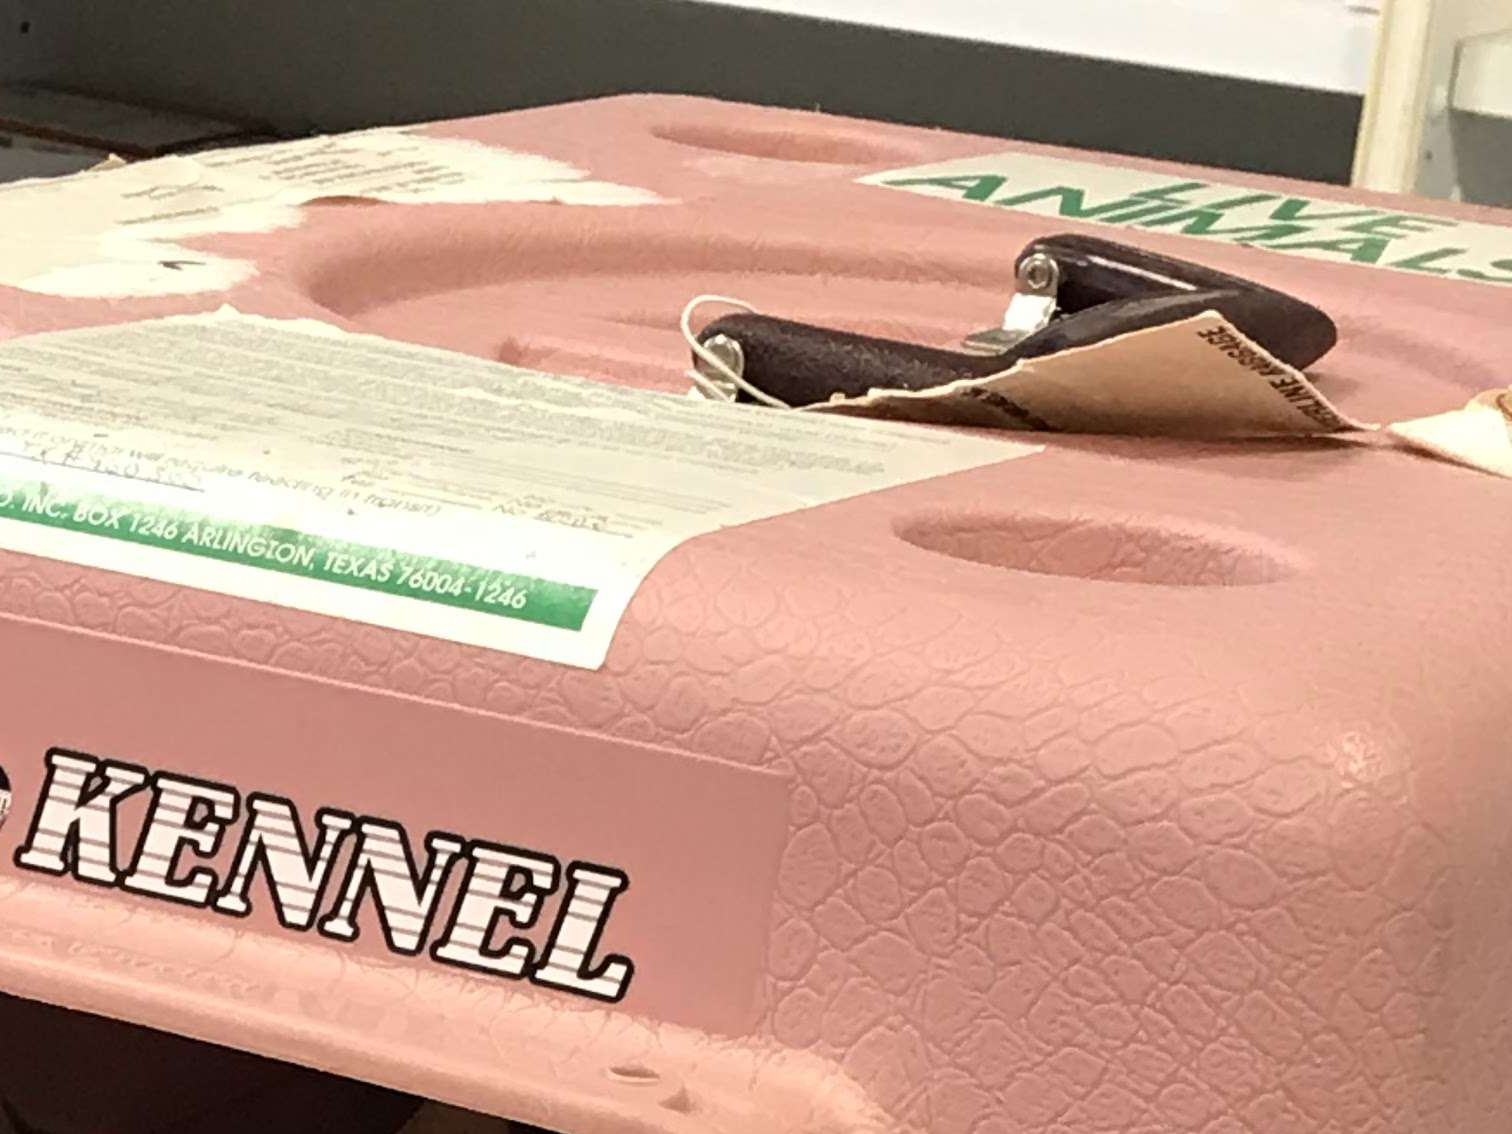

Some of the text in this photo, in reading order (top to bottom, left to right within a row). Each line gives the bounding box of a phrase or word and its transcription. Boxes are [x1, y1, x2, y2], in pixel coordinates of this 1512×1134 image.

[1130, 182, 1461, 240] LIVE
[73, 501, 125, 530] BOX
[129, 511, 179, 540] 1246
[322, 549, 395, 583] TEXAS
[395, 565, 528, 609] 76004-1246
[13, 746, 634, 1003] KENNEL
